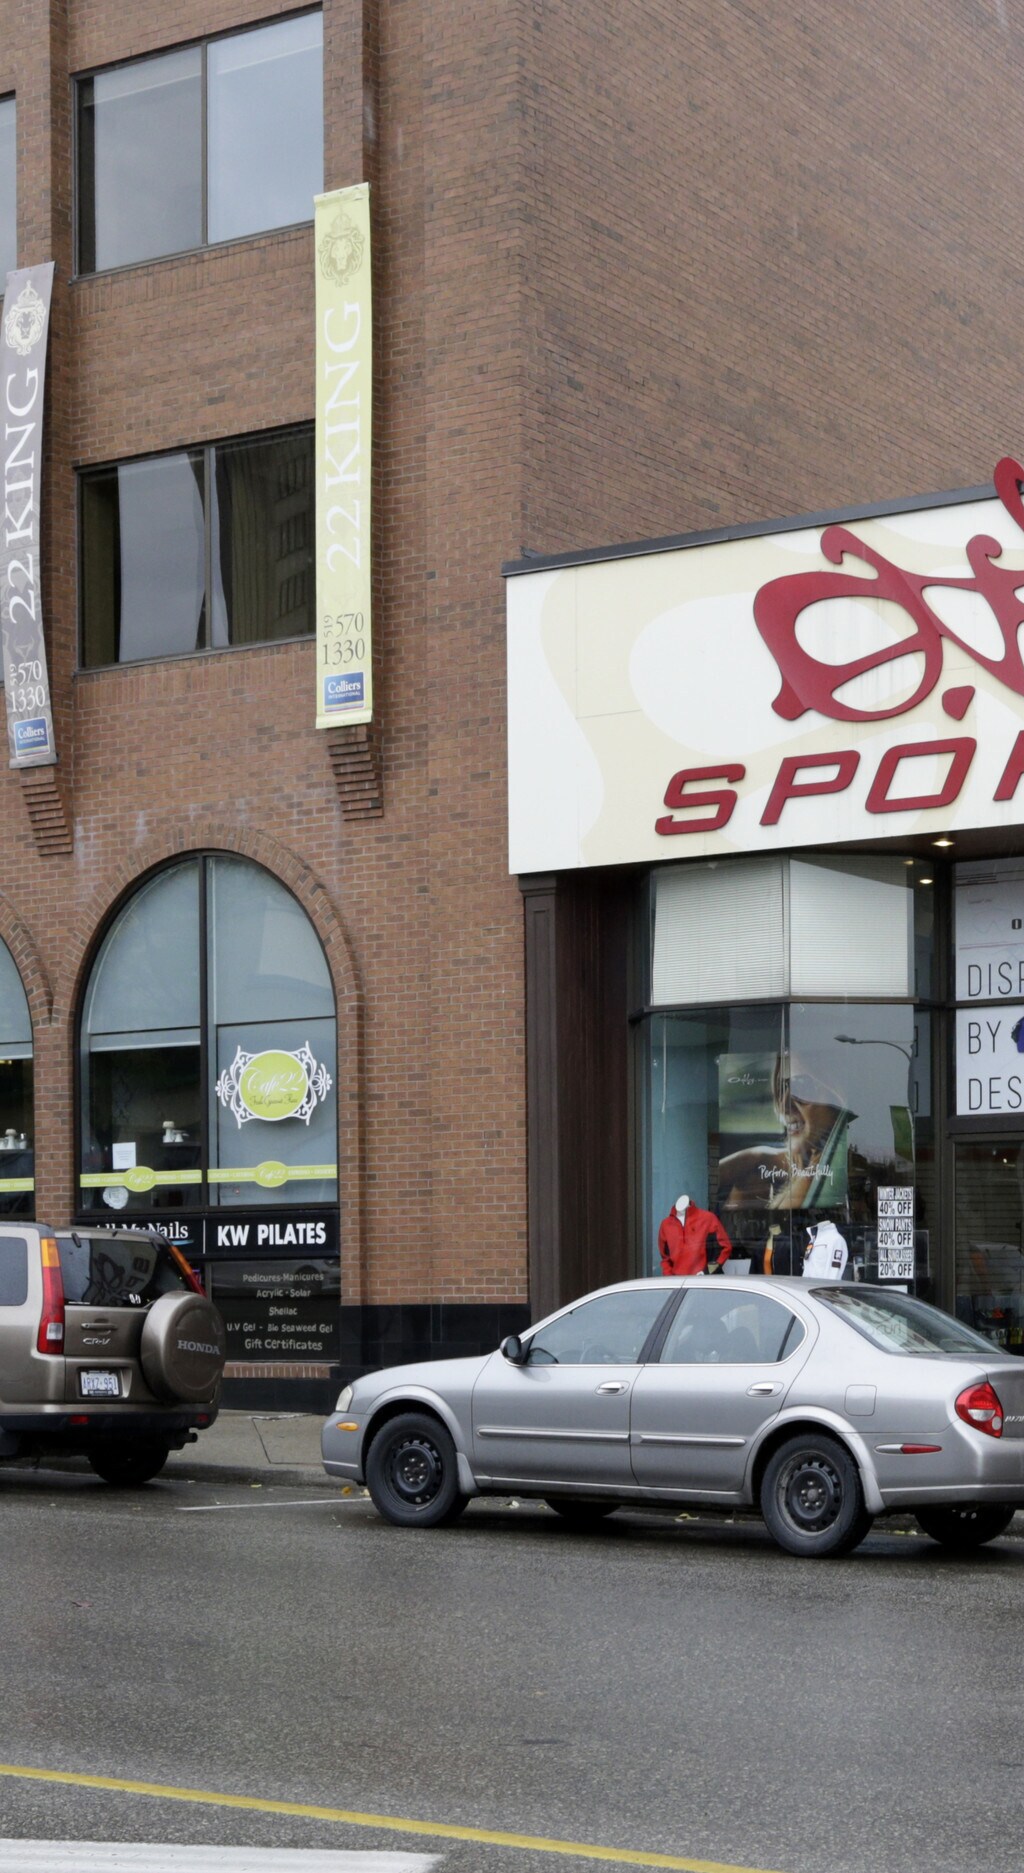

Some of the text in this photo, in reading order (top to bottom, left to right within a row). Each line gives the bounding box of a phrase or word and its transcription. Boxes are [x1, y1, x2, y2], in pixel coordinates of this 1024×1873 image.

[324, 301, 362, 572] 22 KING
[5, 368, 40, 625] 22 KING
[323, 615, 333, 638] 519
[335, 612, 364, 638] 570
[322, 638, 366, 665] 1330
[17, 660, 42, 686] 570
[328, 681, 361, 694] Colliers
[10, 686, 46, 712] 1330
[17, 727, 45, 739] Colliers
[968, 1020, 1002, 1055] BY
[758, 1164, 789, 1183] Perform
[879, 1202, 912, 1215] 40% OFF
[895, 1218, 912, 1231] PANTS
[217, 1222, 327, 1246] KW PILATES
[879, 1232, 912, 1246] 40% OFF
[879, 1263, 912, 1277] 20% OFF
[290, 1288, 312, 1298] Solar
[268, 1307, 298, 1316] Shellac
[242, 1323, 256, 1332] Gel
[267, 1324, 278, 1332] Bio
[281, 1324, 316, 1332] Seaweed
[319, 1324, 333, 1333] Gel
[177, 1340, 221, 1355] HONDA
[244, 1339, 323, 1351] Gift Certificates
